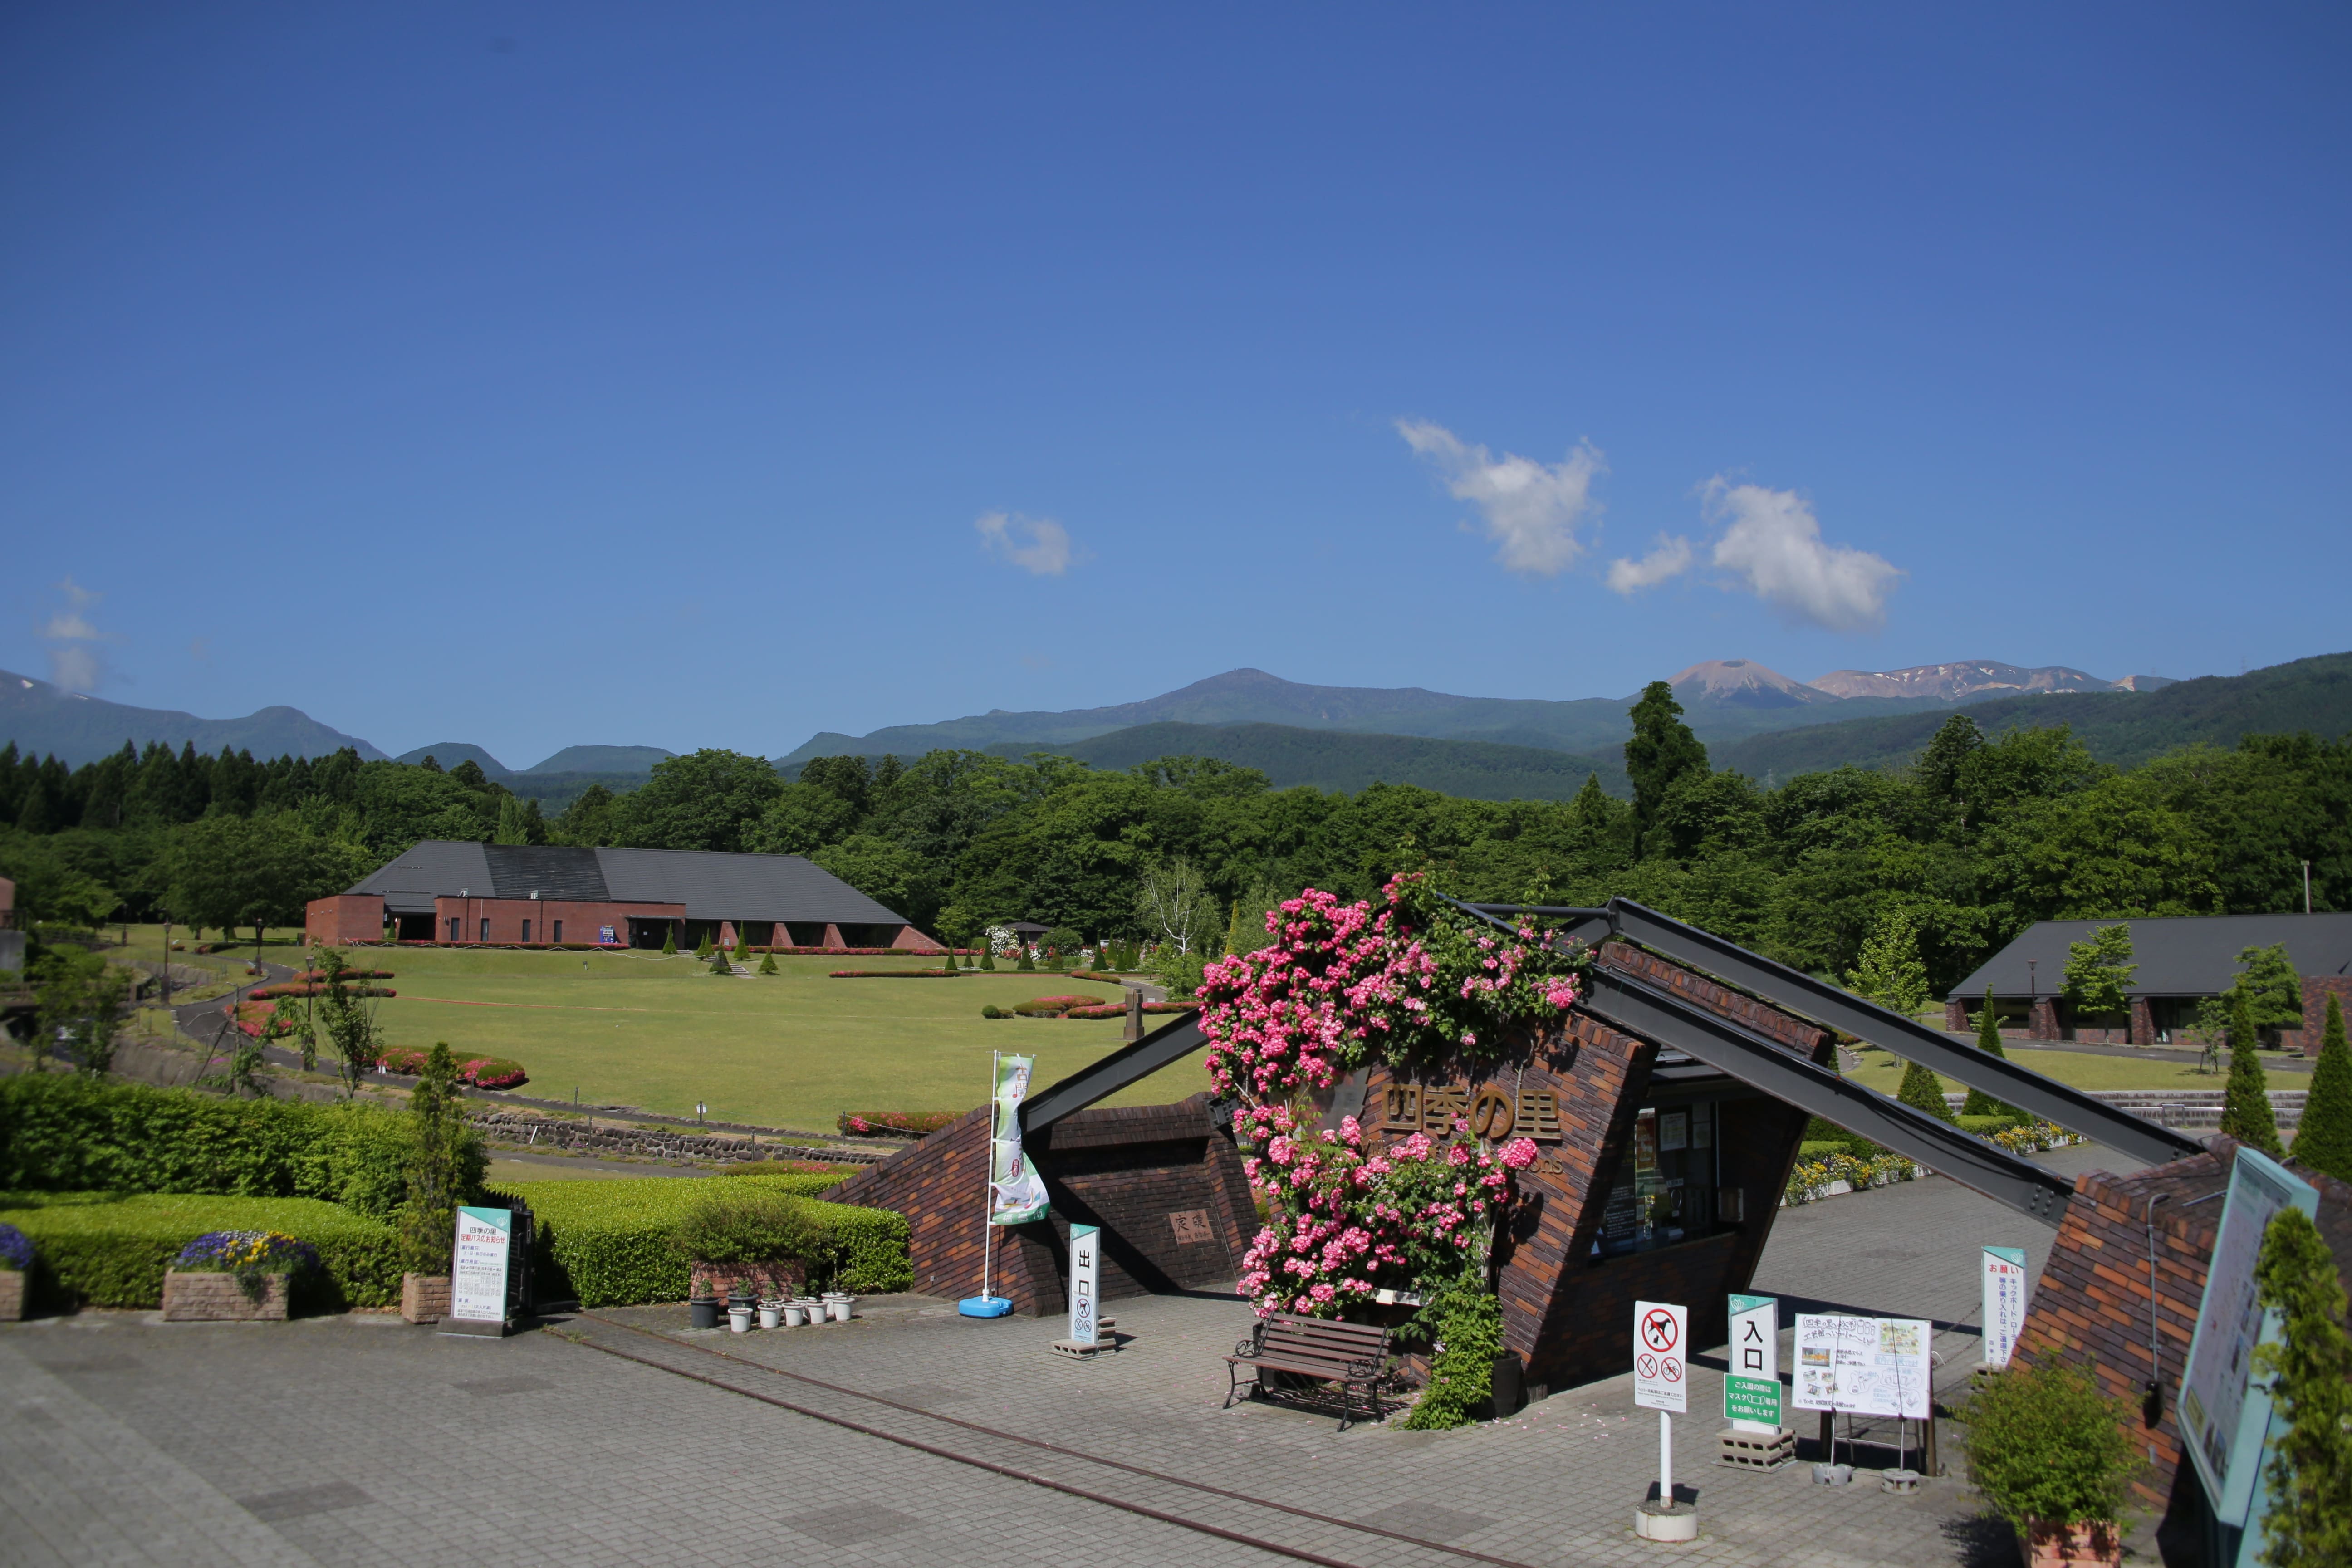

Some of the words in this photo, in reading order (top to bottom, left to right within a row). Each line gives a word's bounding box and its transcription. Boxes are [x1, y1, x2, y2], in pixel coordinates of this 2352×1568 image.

[1382, 1084, 1562, 1139] 四季の里
[1002, 1209, 1043, 1223] 福島市
[461, 1234, 505, 1244] 定期バスのお知らせ
[1079, 1250, 1090, 1298] 出口
[1989, 1264, 2019, 1274] お願い
[1743, 1320, 1763, 1371] 入口
[1735, 1381, 1771, 1393] ご入園の際は
[1728, 1392, 1747, 1401] マスク
[1765, 1397, 1778, 1406] 着用
[1731, 1404, 1774, 1417] をお願いします
